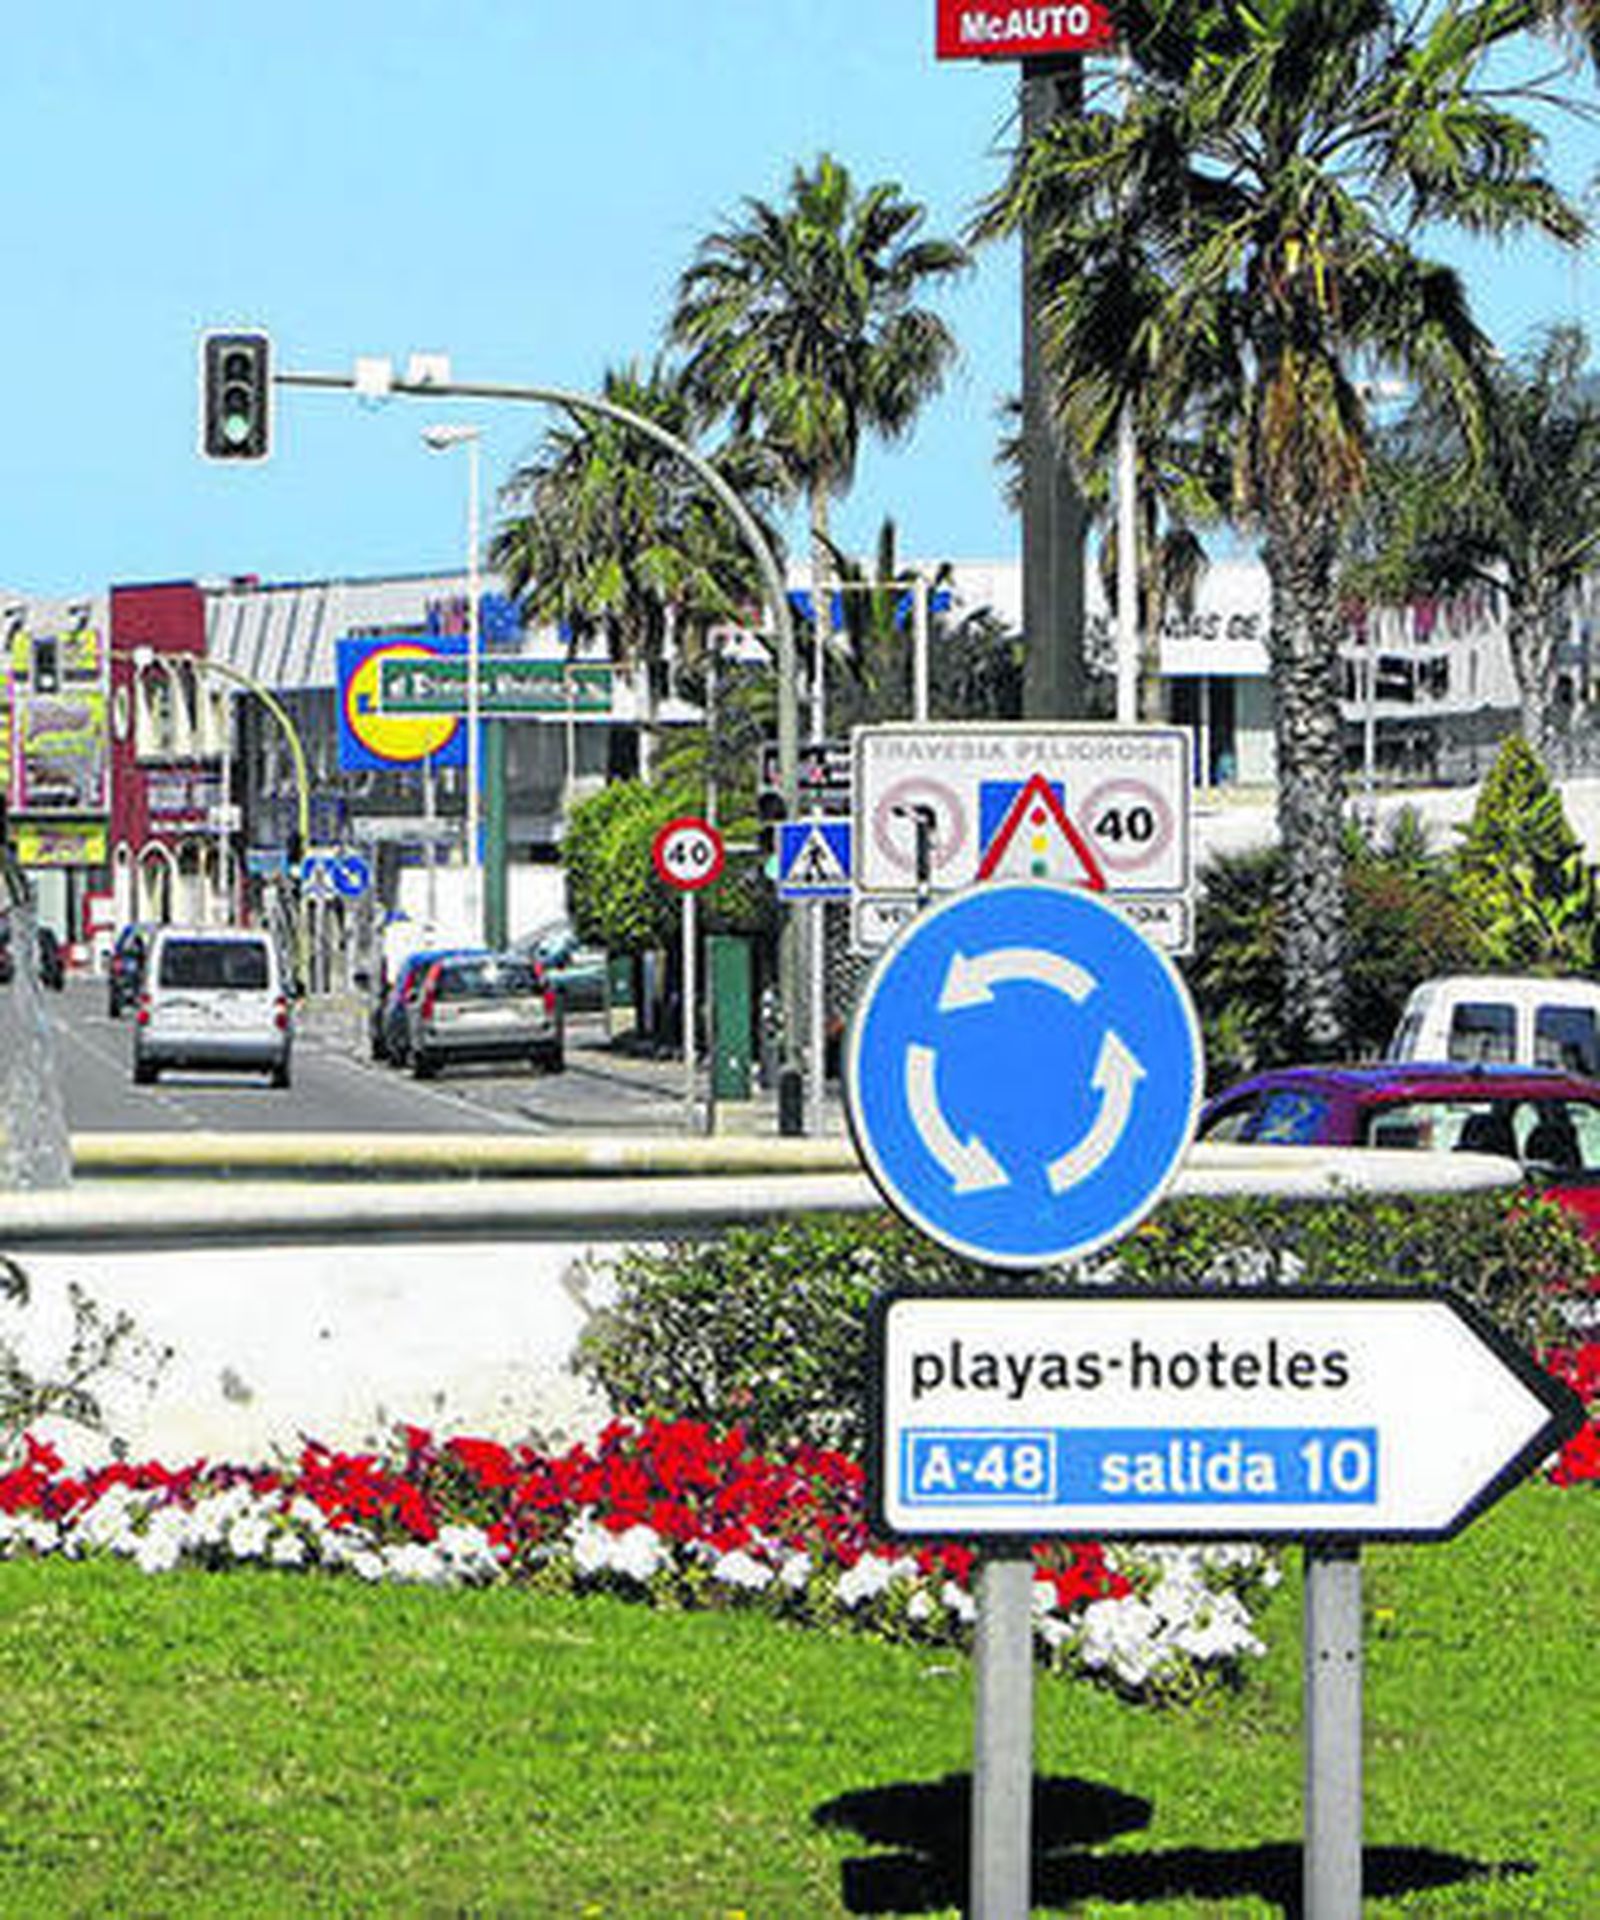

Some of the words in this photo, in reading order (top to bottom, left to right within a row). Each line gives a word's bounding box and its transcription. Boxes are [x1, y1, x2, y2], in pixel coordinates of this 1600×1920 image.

[960, 5, 1091, 43] McAUTO
[1094, 806, 1154, 842] 40
[668, 840, 710, 866] 40
[911, 1339, 1350, 1400] playas-hoteles
[919, 1445, 1044, 1491] A-48
[1100, 1439, 1277, 1493] salida
[1301, 1439, 1371, 1493] 10
